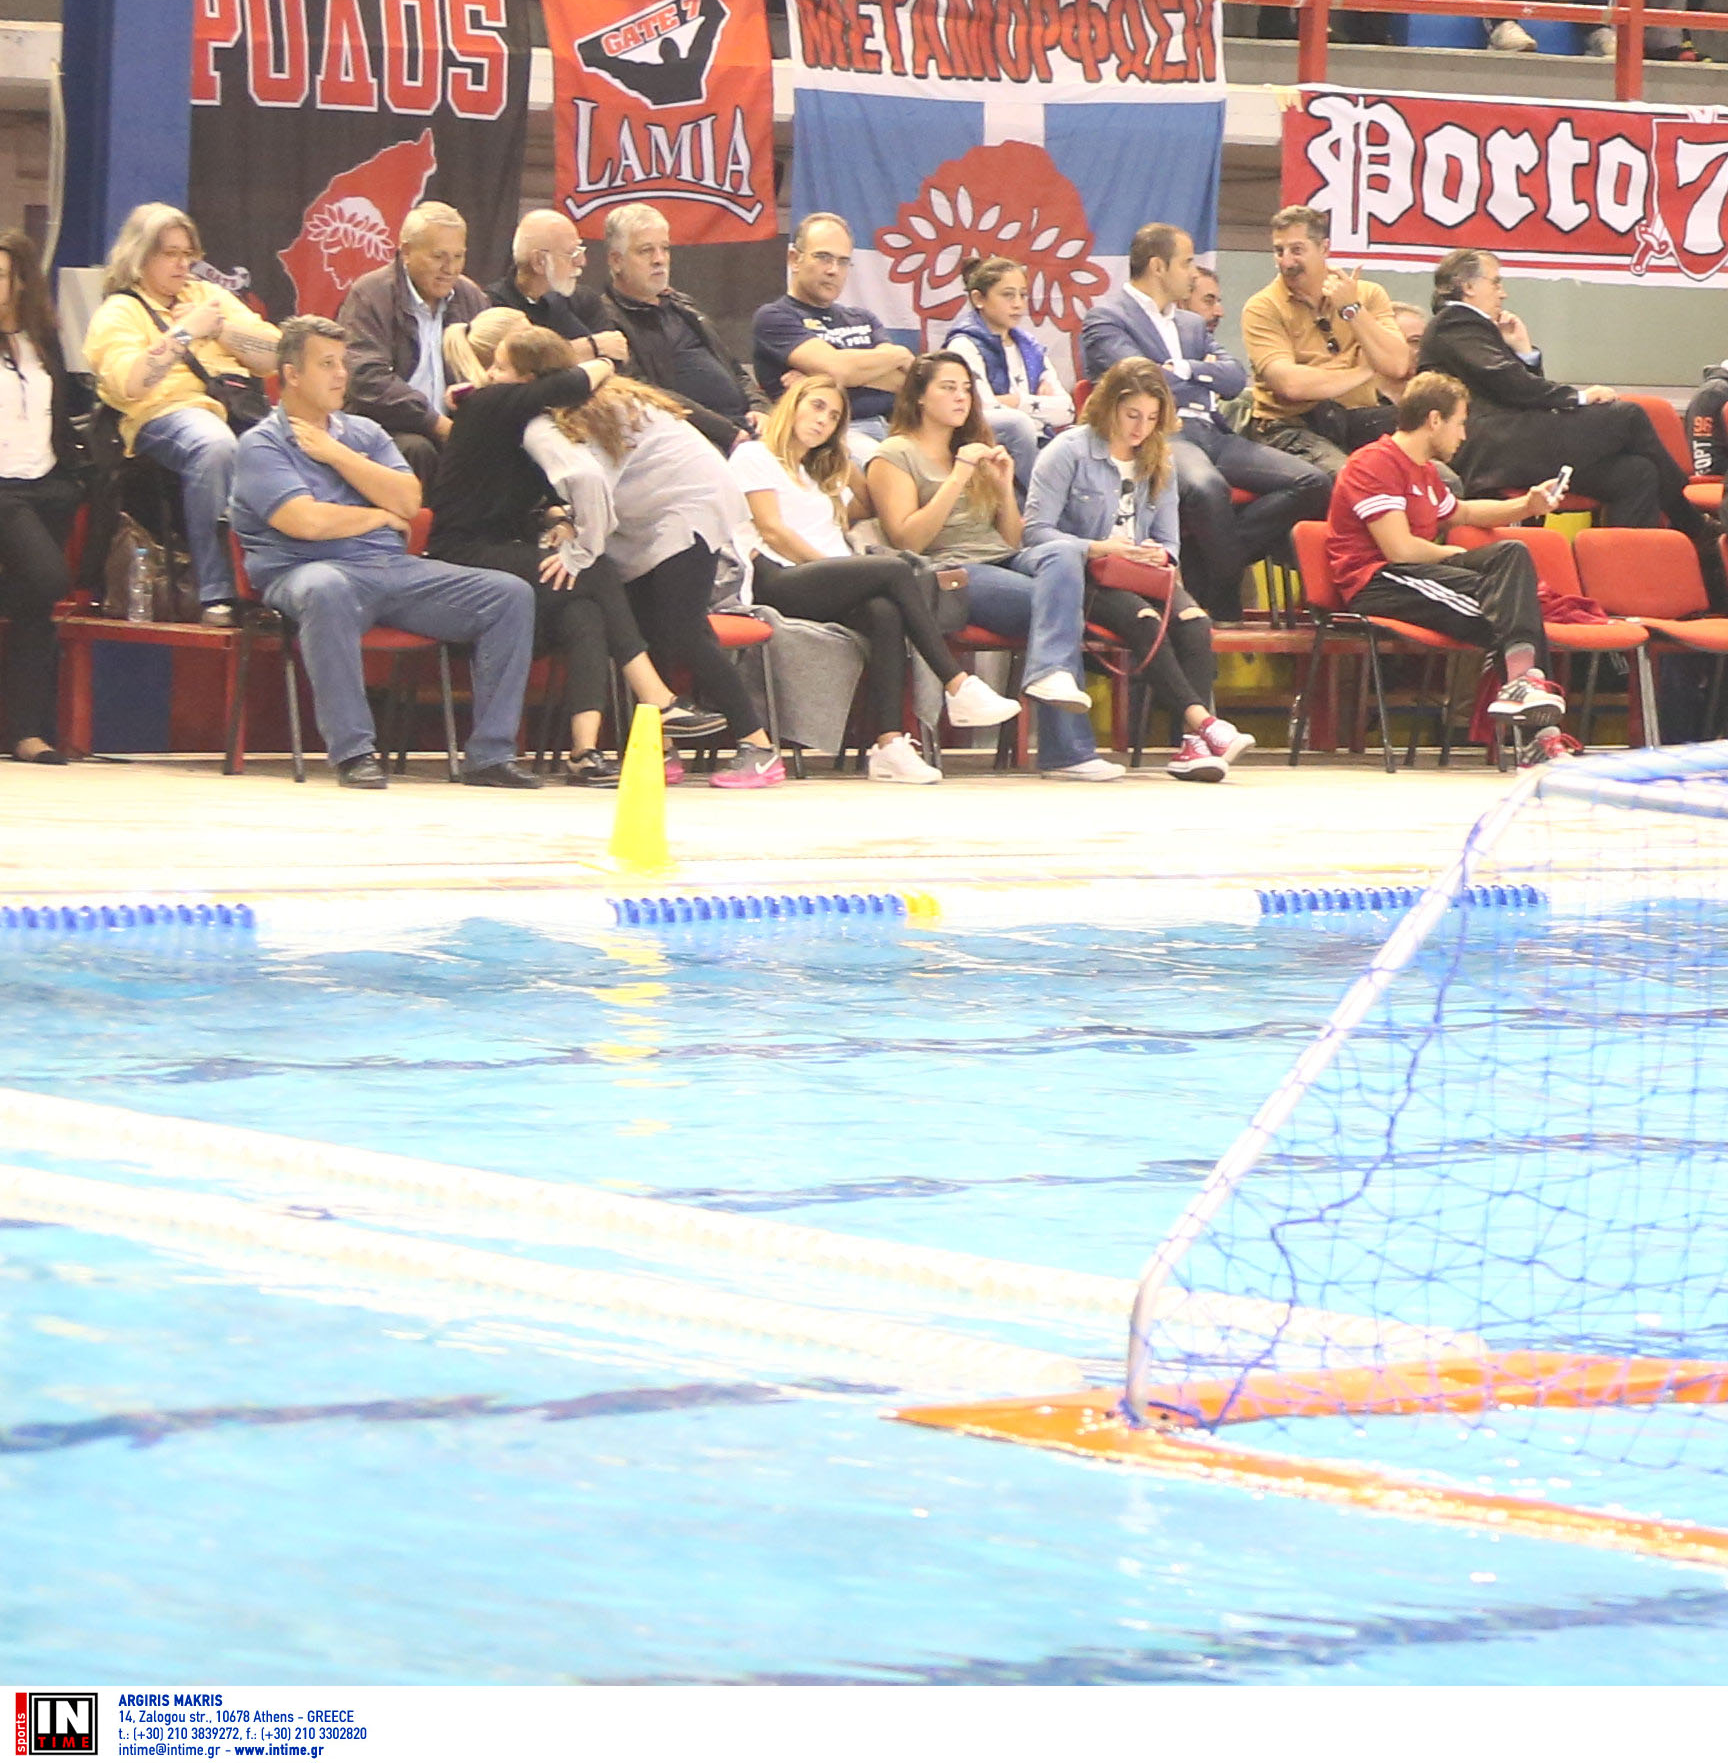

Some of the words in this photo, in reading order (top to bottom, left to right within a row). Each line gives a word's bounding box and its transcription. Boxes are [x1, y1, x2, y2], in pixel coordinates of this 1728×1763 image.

[601, 6, 681, 57] GATE
[571, 97, 754, 197] LAMIA
[1305, 94, 1650, 249] Porto
